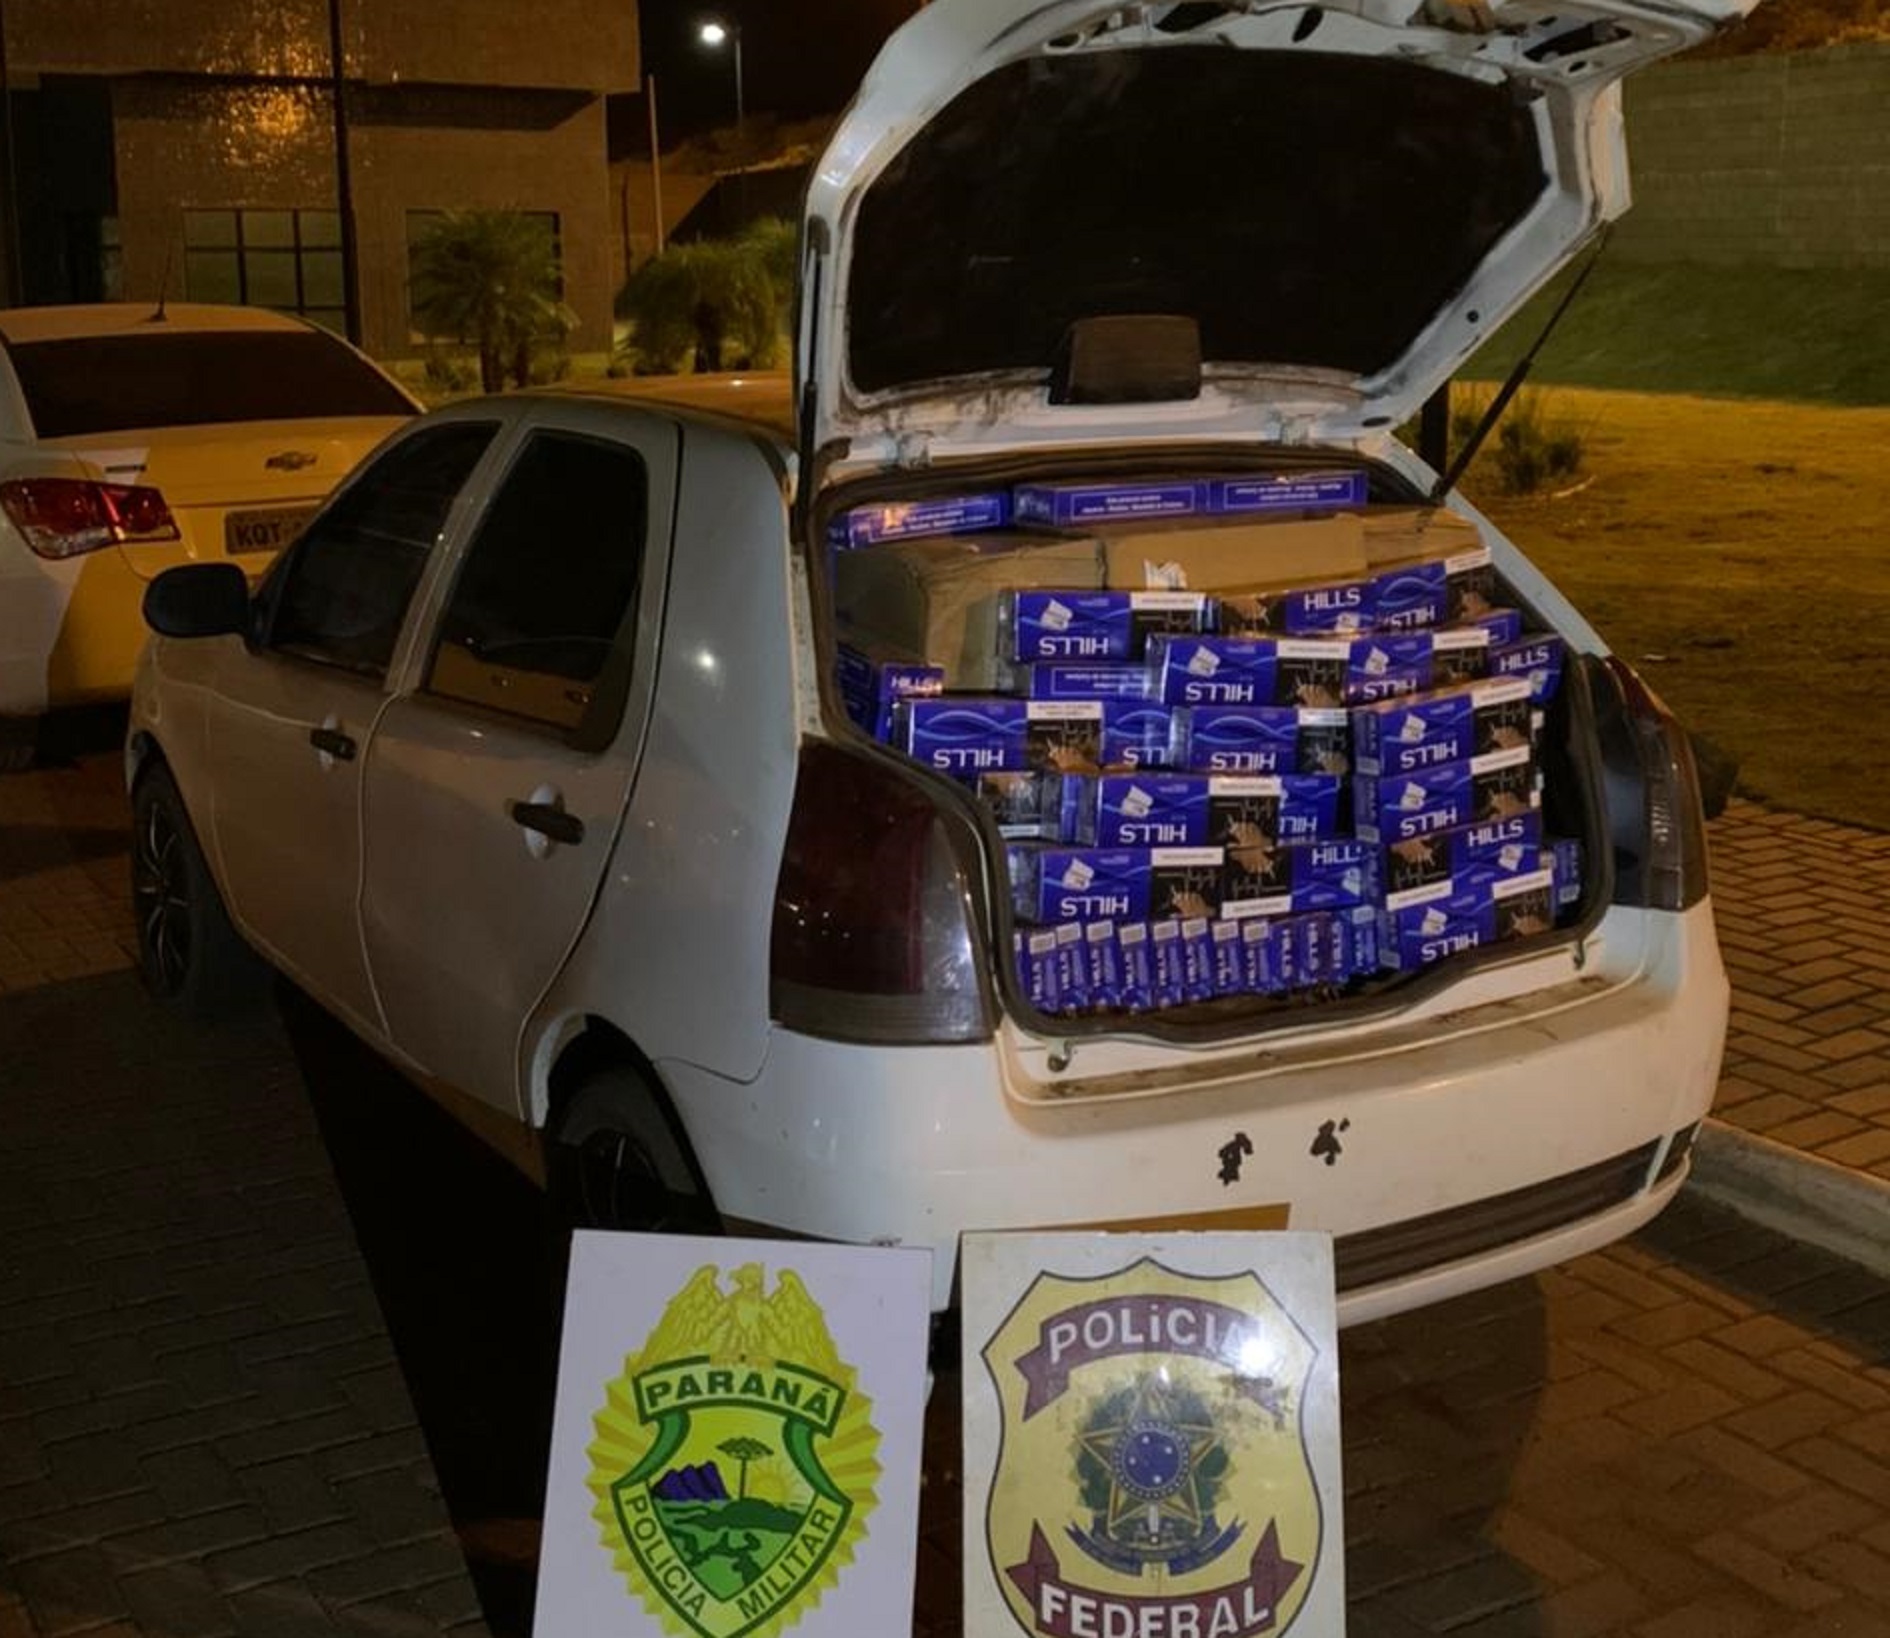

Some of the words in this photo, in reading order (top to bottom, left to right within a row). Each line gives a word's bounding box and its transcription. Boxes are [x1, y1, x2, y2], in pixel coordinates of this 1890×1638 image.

[1304, 587, 1361, 611] HILLS
[1039, 636, 1109, 655] HILLS
[1500, 646, 1549, 672] HILLS
[1185, 681, 1254, 702] HILLS
[933, 749, 1004, 768] HILLS
[1211, 751, 1276, 770] HILLS
[1400, 740, 1457, 768] HILLS
[1119, 823, 1186, 843] HILLS
[1400, 807, 1457, 836] HILLS
[1468, 819, 1524, 847] HILLS
[1061, 896, 1129, 916] HILLS
[1421, 931, 1479, 962] HILLS
[645, 1370, 829, 1421] PARANÁ
[736, 1508, 835, 1619] MILITAR
[1041, 1582, 1269, 1638] FEDERAL
